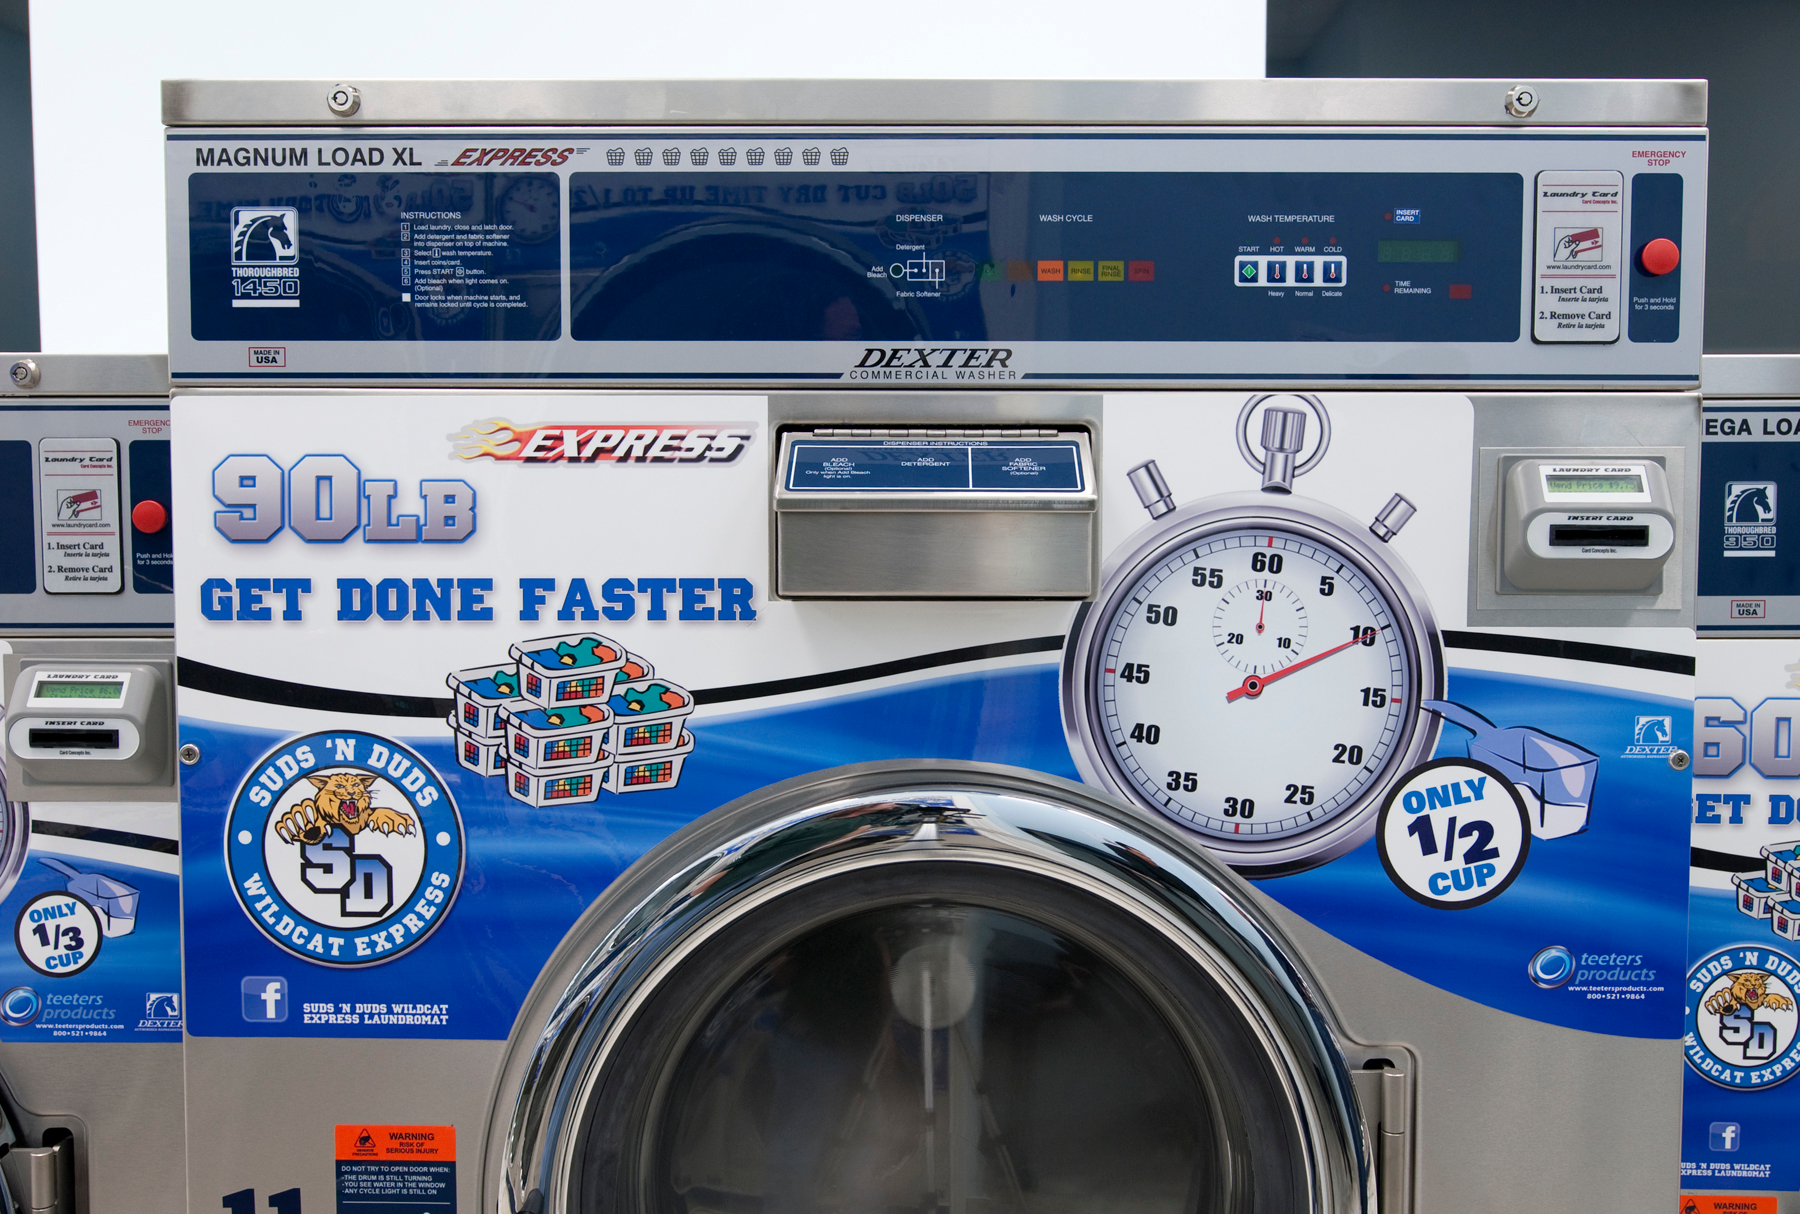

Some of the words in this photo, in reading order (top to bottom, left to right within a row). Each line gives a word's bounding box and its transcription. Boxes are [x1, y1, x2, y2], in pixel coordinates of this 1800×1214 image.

[195, 148, 308, 166] MAGNUM
[318, 148, 384, 166] LOAD
[392, 148, 422, 166] XL
[450, 148, 574, 166] EXPRESS
[232, 268, 299, 277] THOROUGHBRED
[232, 279, 299, 296] 1450
[1540, 286, 1548, 294] 1.
[1551, 286, 1577, 294] Insert
[1580, 286, 1602, 294] Card
[1539, 312, 1547, 320] 2.
[1550, 312, 1585, 320] Remove
[1588, 311, 1611, 320] Card
[256, 356, 277, 364] USA
[854, 349, 1012, 368] DEXTER
[850, 371, 948, 379] COMMERCIAL
[956, 371, 1016, 379] WASHER
[1702, 418, 1752, 435] EGA
[518, 429, 752, 463] EXPRESS
[213, 454, 476, 544] 90LB
[1724, 535, 1776, 548] 950
[1252, 552, 1283, 574] 60
[1192, 567, 1223, 589] 55
[1320, 576, 1334, 596] 5
[200, 578, 312, 621] GET
[337, 578, 493, 621] DONE
[519, 578, 758, 621] FASTER
[1256, 590, 1272, 601] 30
[1146, 604, 1178, 626] 50
[1227, 633, 1244, 644] 20
[1277, 637, 1291, 649] 10
[1350, 626, 1376, 646] 10
[1120, 662, 1150, 684] 45
[1360, 688, 1387, 708] 15
[1130, 723, 1160, 744] 40
[1332, 744, 1363, 765] 20
[1625, 746, 1678, 754] DEXTER
[249, 744, 316, 807] SUDS
[367, 744, 439, 807] DUDS
[1166, 771, 1198, 792] 35
[1284, 784, 1315, 805] 25
[1403, 776, 1487, 814] ONLY
[1223, 797, 1254, 818] 30
[1407, 814, 1500, 865] 1/2
[1428, 863, 1496, 896] CUP
[29, 902, 77, 923] ONLY
[243, 872, 344, 955] WILDCAT
[354, 871, 451, 956] EXPRESS
[32, 923, 84, 951] 1/3
[45, 951, 84, 969] CUP
[1581, 952, 1643, 966] teeters
[1576, 968, 1656, 984] products
[1568, 985, 1664, 993] www.teetersproducts.com
[47, 993, 103, 1005] teeters
[42, 1008, 116, 1022] products
[303, 1004, 334, 1013] SUDS
[356, 1004, 387, 1013] DUDS
[391, 1004, 448, 1014] WILDCAT
[304, 1015, 359, 1024] EXPRESS
[364, 1015, 448, 1024] LAUNDROMAT
